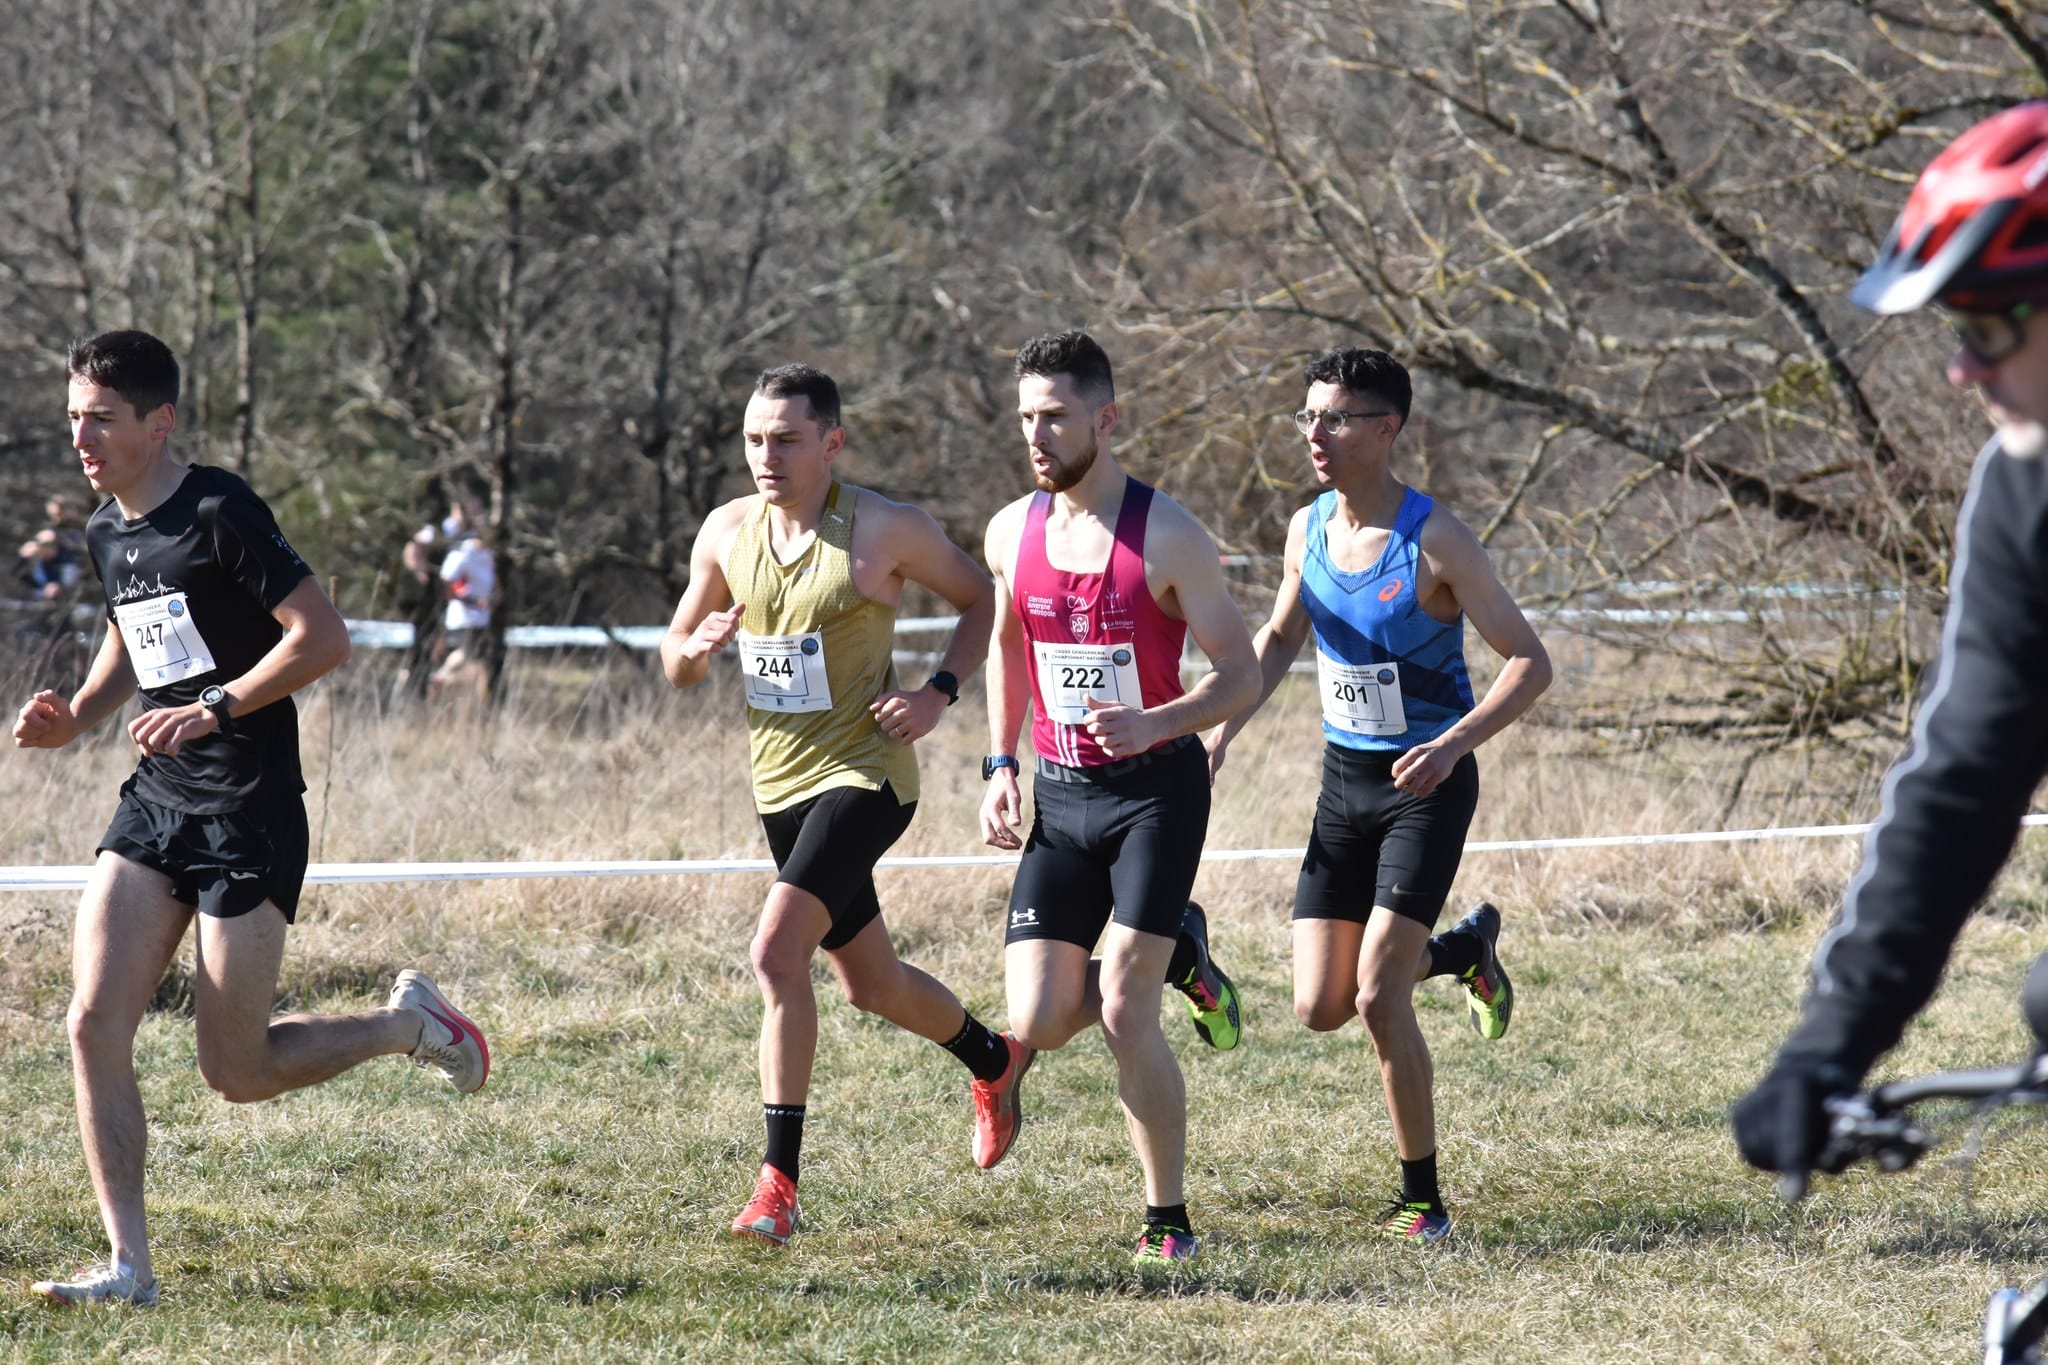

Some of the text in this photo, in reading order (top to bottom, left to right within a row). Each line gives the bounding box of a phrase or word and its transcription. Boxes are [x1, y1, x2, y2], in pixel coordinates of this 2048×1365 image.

[1028, 595, 1053, 604] clermont
[136, 623, 163, 649] 247
[756, 657, 794, 677] 244
[1061, 667, 1105, 688] 222
[1333, 681, 1368, 704] 201
